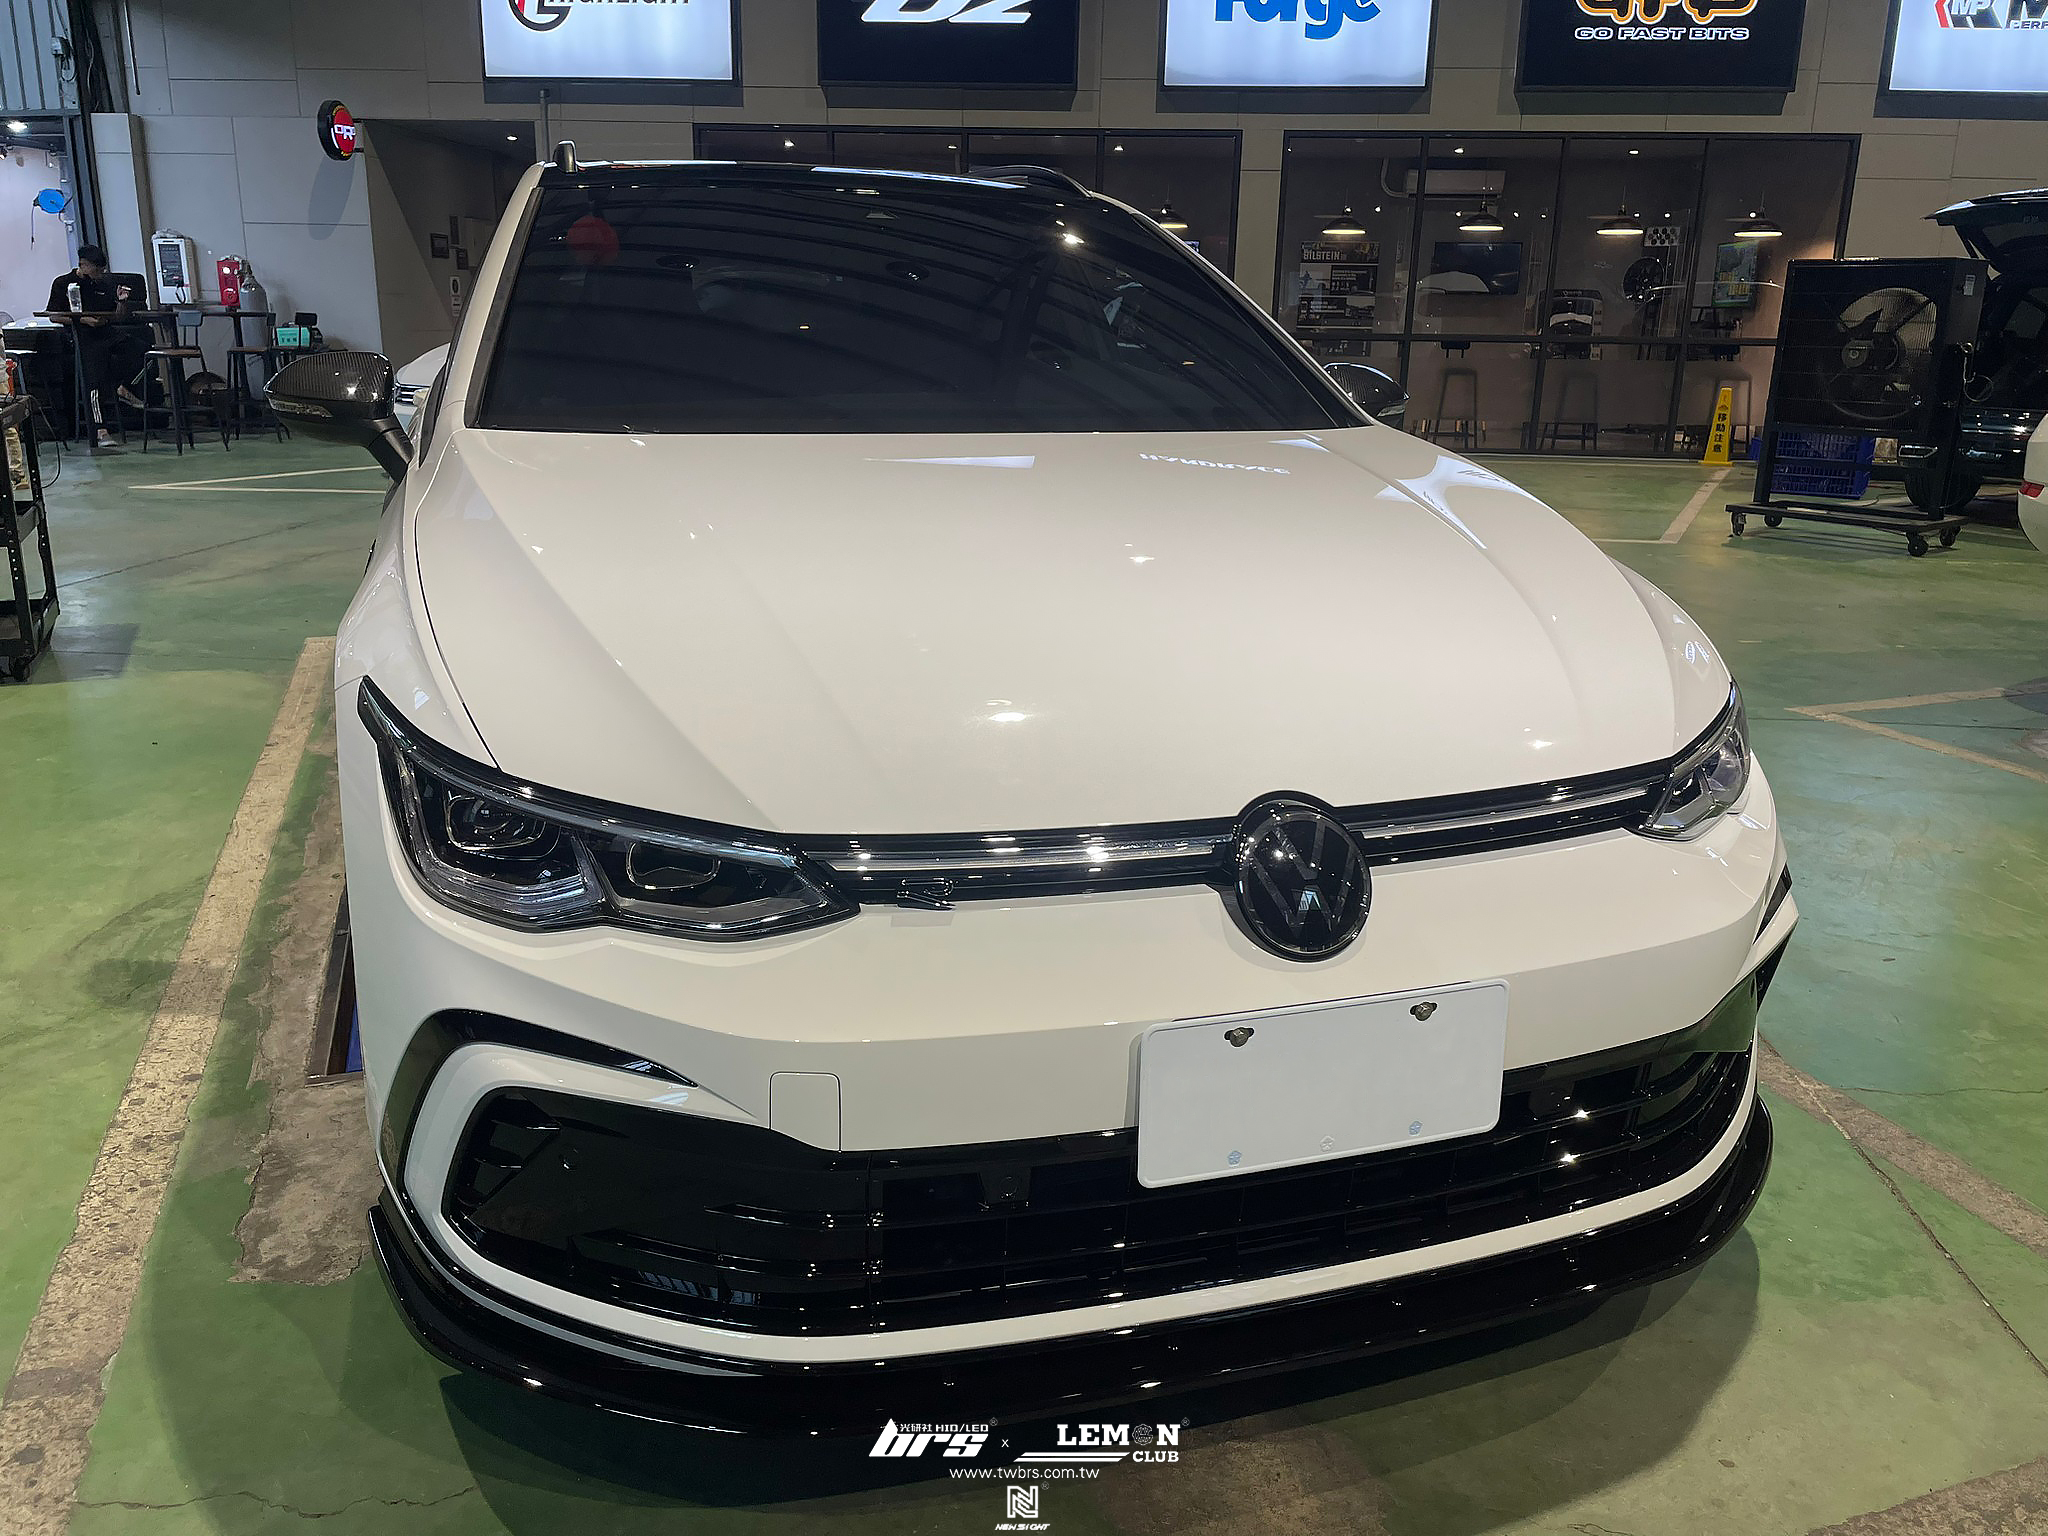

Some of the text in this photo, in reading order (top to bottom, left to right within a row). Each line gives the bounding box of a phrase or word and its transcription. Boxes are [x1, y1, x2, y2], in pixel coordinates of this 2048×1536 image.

[1575, 27, 1750, 40] GO FAST BITS
[1303, 250, 1341, 261] BILSTEIN
